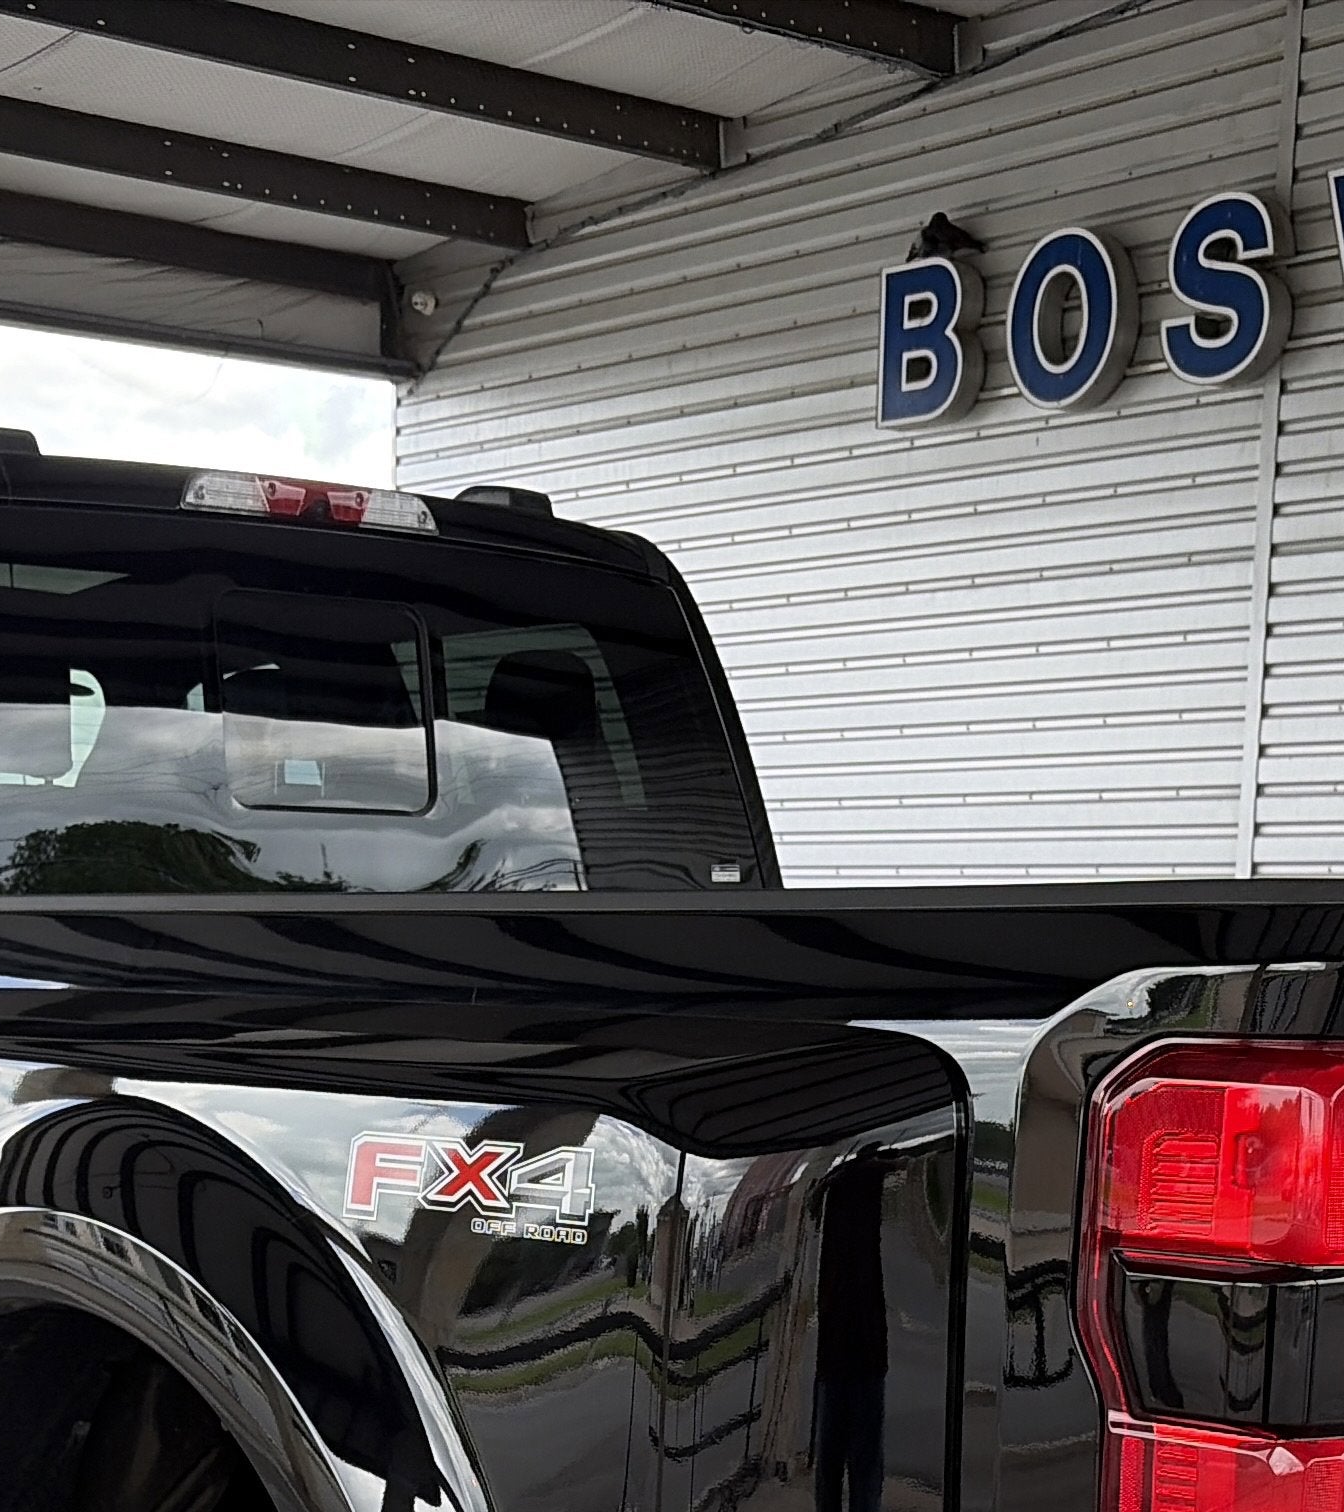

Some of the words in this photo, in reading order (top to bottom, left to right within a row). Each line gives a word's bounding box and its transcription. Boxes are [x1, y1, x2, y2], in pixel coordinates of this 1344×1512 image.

[343, 1130, 594, 1226] FX4
[471, 1217, 517, 1236] OFF
[523, 1222, 588, 1245] ROAD
